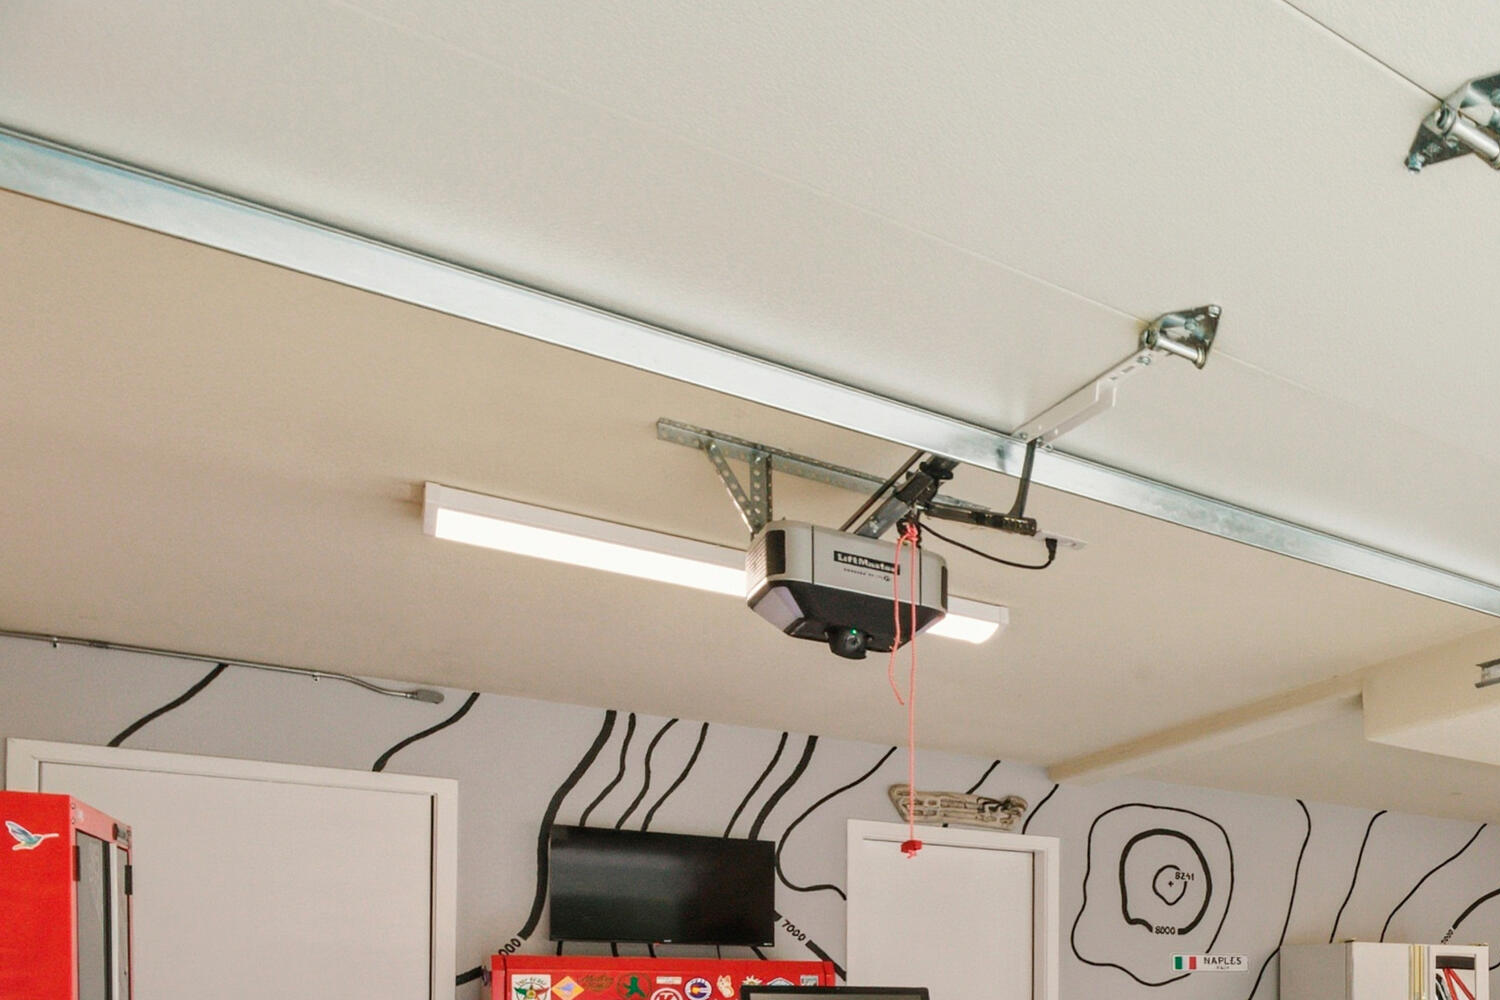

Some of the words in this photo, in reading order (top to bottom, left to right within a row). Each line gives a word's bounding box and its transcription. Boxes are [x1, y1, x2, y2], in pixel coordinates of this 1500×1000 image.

[781, 919, 807, 942] 7000
[1154, 925, 1176, 935] 8000
[1203, 956, 1242, 966] NAPLES
